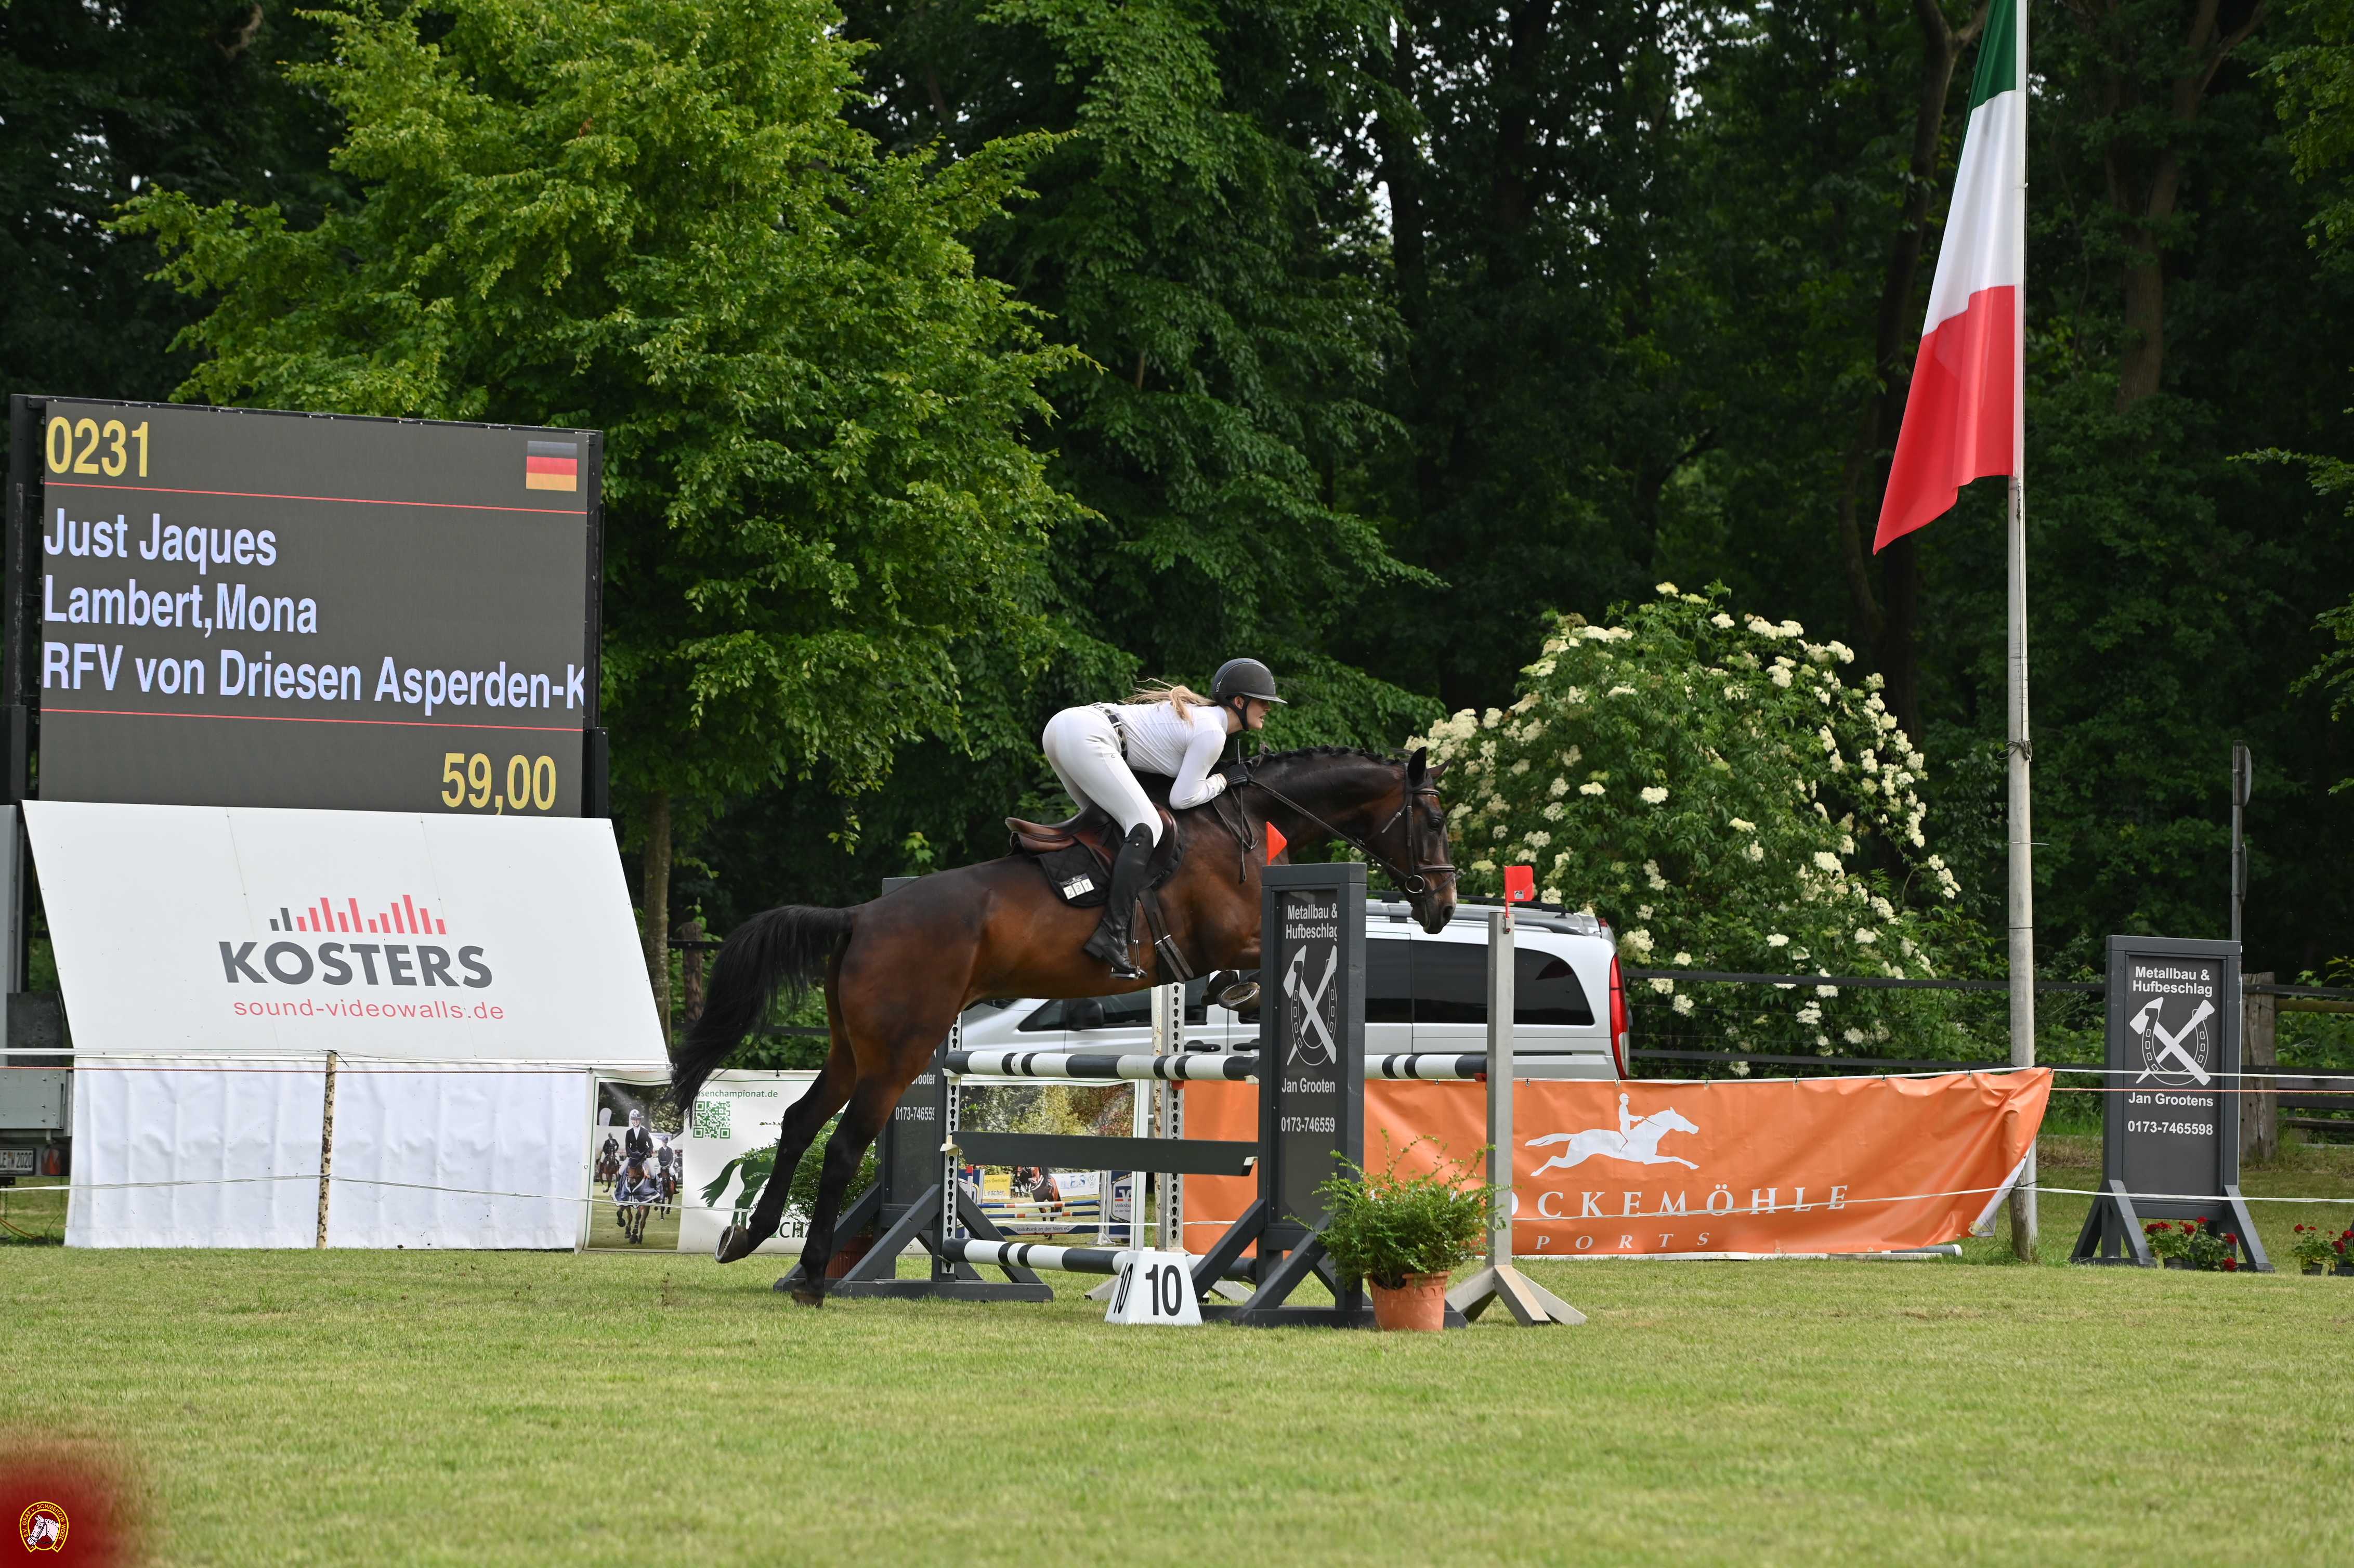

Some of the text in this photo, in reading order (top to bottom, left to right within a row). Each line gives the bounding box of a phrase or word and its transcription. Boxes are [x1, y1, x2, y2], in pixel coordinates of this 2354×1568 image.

[46, 416, 148, 477] 0231
[44, 507, 277, 575] Just Jaques
[44, 574, 317, 638] Lambert,Mona
[43, 642, 585, 716] RFV von Driesen Asperden-K
[441, 752, 556, 815] 59,00
[1288, 903, 1338, 920] Metallbau &
[219, 941, 492, 988] KOSTERS
[2135, 966, 2210, 981] Metallbau &
[2133, 981, 2213, 998] Hufbeschlag
[234, 999, 504, 1021] sound-videowalls.de
[1281, 1077, 1336, 1093] Jan Grooten
[2128, 1092, 2214, 1107] Jan Grootens
[1280, 1116, 1335, 1133] 0173-746559
[2128, 1120, 2213, 1136] 0173-7465598
[17, 1152, 32, 1169] 2020
[780, 1222, 808, 1238] CH
[1114, 1262, 1133, 1314] 10
[1145, 1264, 1182, 1316] 10
